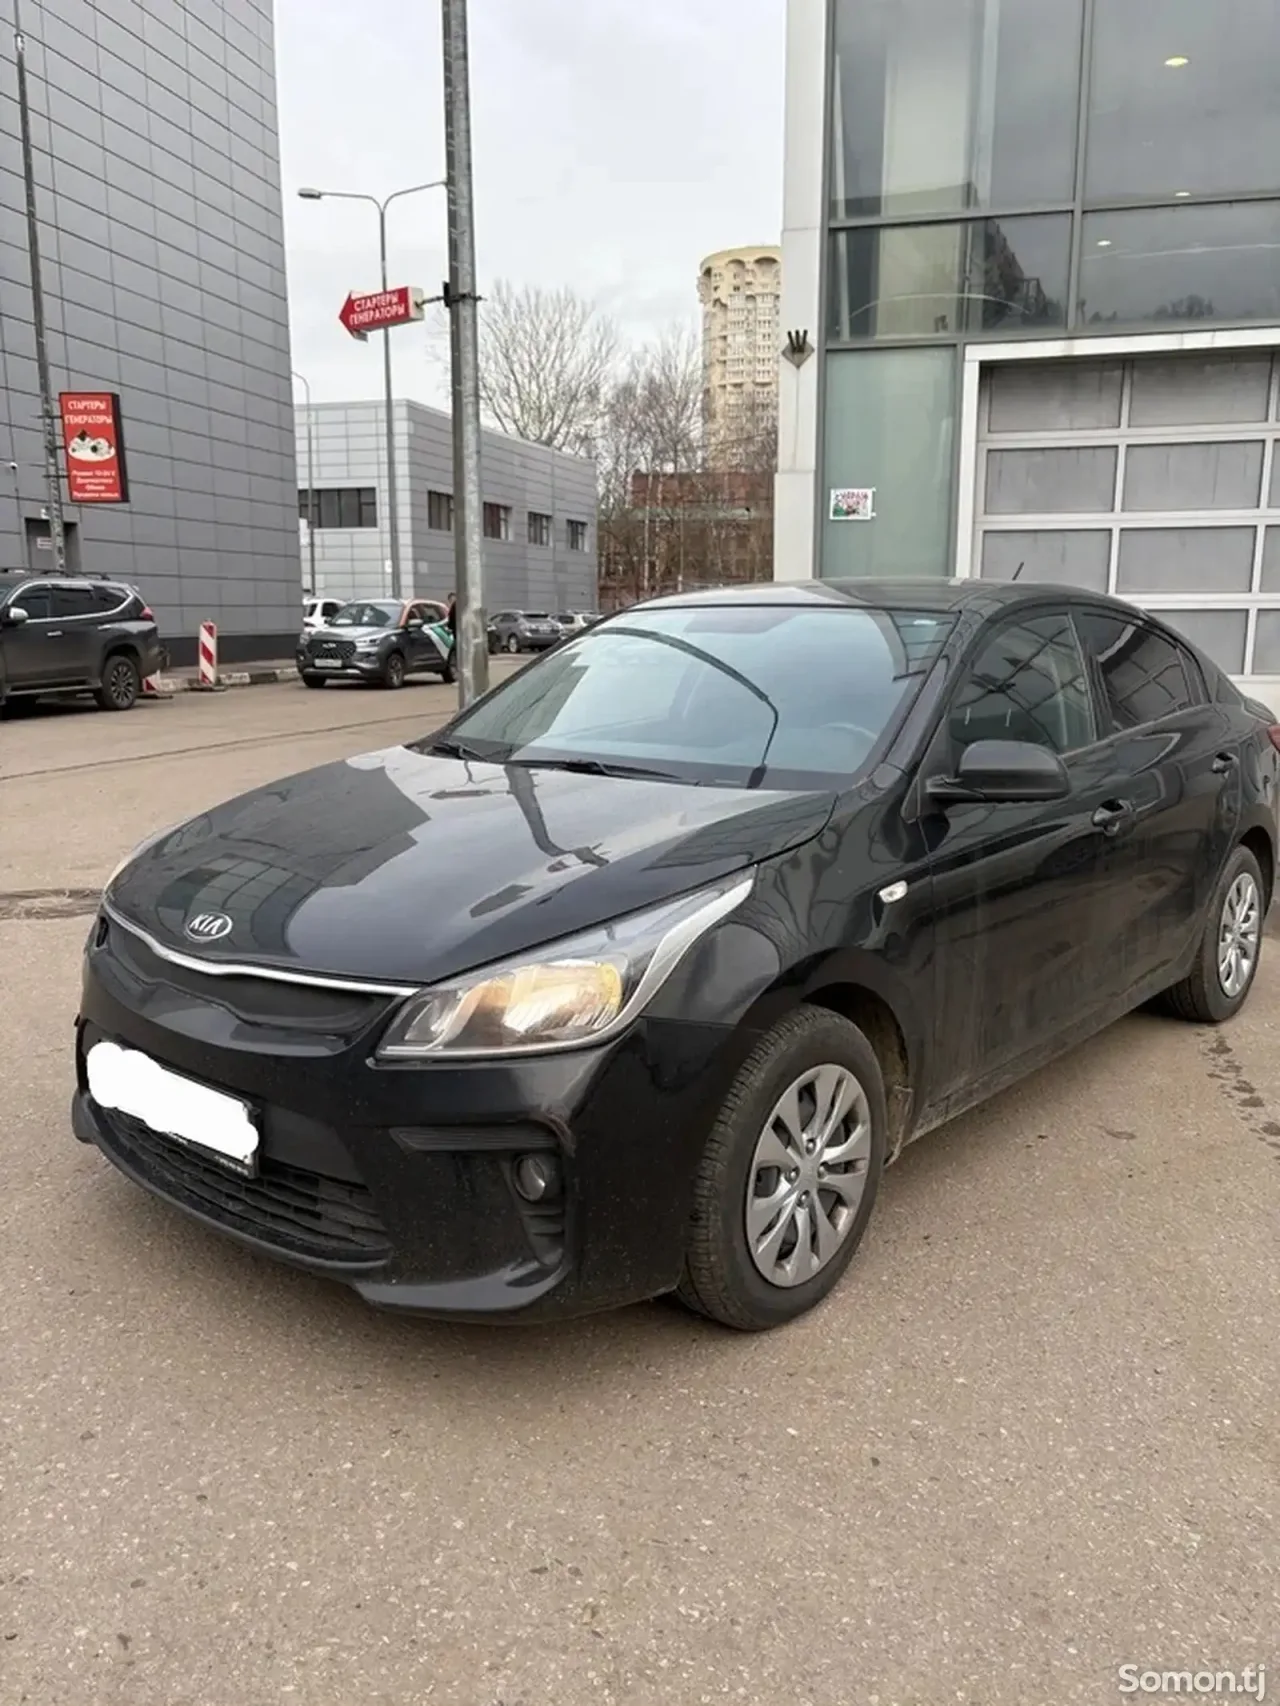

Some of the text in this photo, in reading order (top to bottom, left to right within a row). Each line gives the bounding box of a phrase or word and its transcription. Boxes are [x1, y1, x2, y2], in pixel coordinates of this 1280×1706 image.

[353, 292, 399, 312] СТАРТЕРЫ
[349, 303, 405, 325] ГЕНЕРАТОРЫ
[68, 400, 106, 410] СТАРТЕРЫ
[189, 914, 223, 935] KIA
